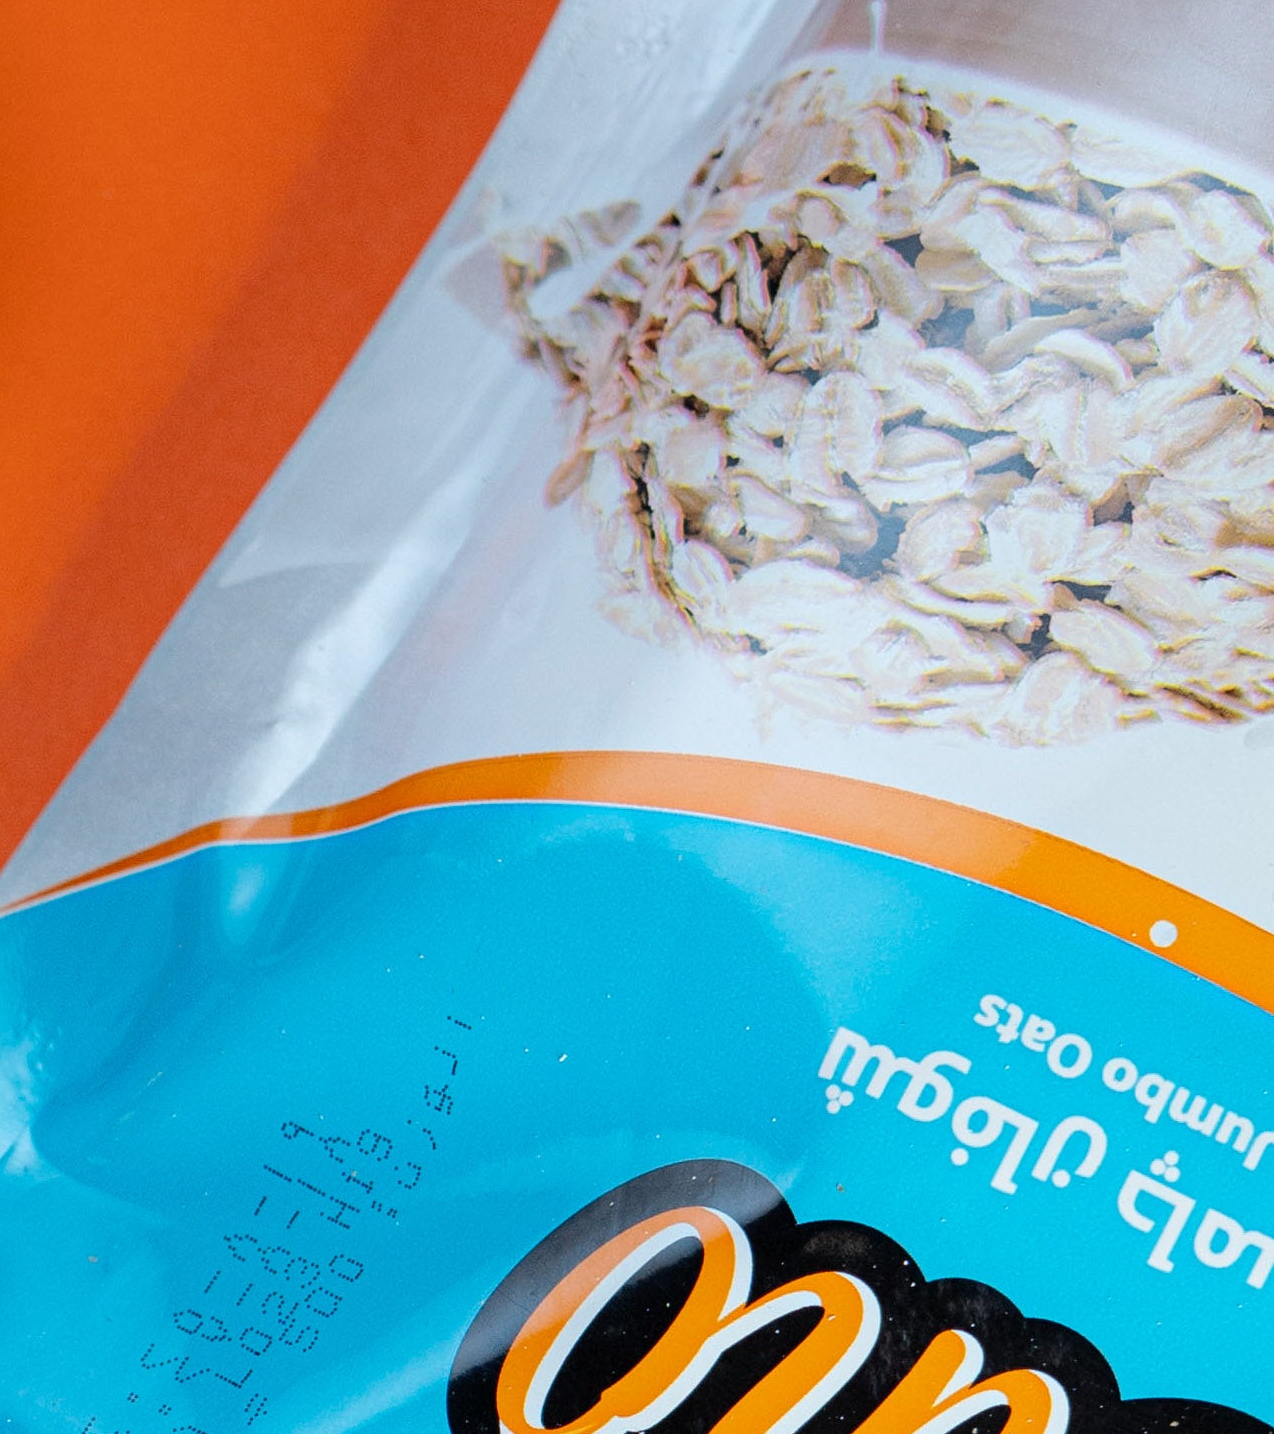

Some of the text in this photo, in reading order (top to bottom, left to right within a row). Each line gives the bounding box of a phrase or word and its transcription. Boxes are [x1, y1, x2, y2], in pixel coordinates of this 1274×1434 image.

[816, 1026, 1108, 1195] شوفان
[973, 993, 1274, 1171] Jumbo Oats
